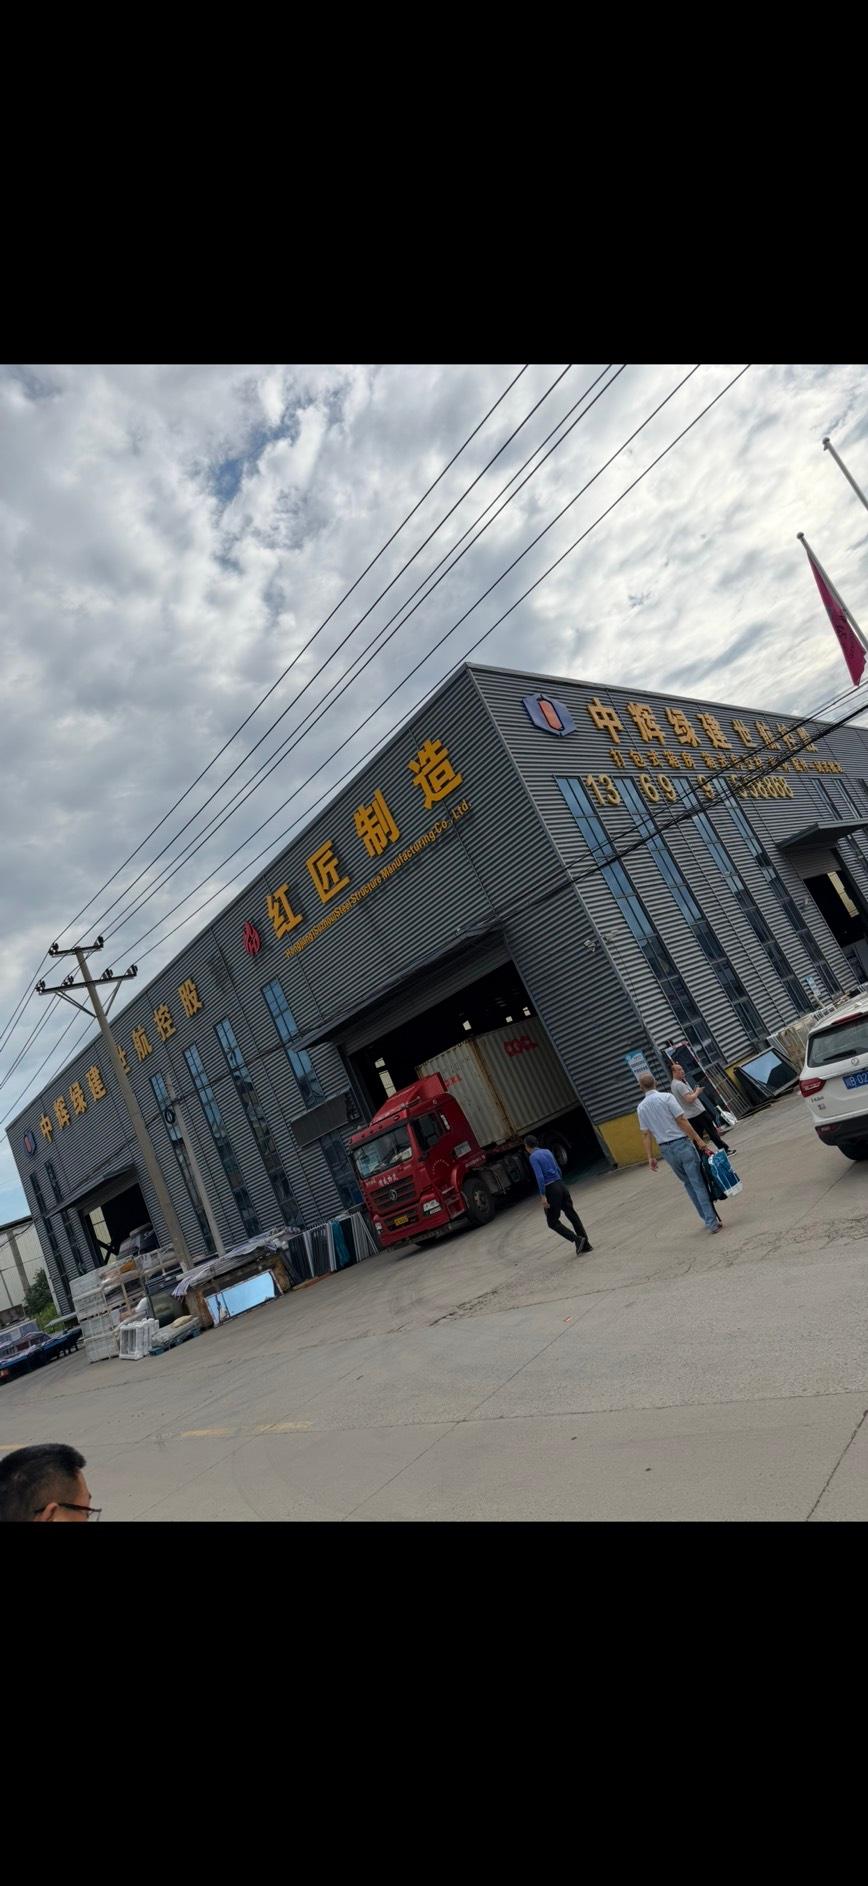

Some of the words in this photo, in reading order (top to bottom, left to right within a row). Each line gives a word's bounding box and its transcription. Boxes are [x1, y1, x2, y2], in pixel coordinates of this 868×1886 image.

[264, 738, 464, 940] 红匠制造
[381, 829, 436, 880] Manufacturing
[451, 799, 472, 820] Ltd.
